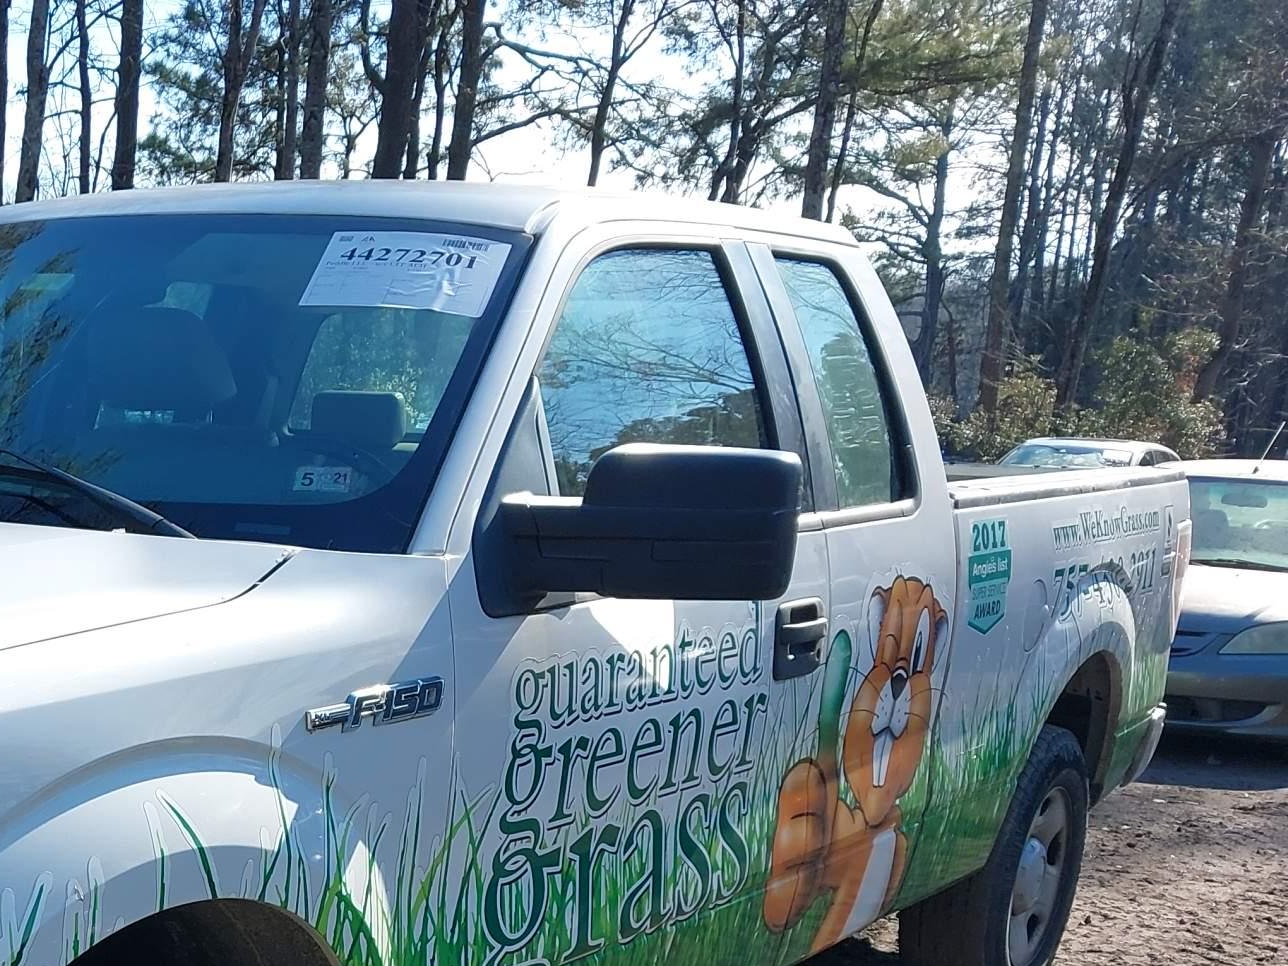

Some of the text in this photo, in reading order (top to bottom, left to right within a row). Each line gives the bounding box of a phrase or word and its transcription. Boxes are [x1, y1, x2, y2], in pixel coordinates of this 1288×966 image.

[341, 247, 478, 269] 44272701
[300, 472, 314, 487] 5
[972, 520, 1006, 552] 2017
[997, 556, 1008, 572] list
[974, 600, 1001, 619] AWARD
[511, 601, 765, 752] guaranteed
[341, 676, 445, 733] F-150
[498, 690, 768, 876] greener
